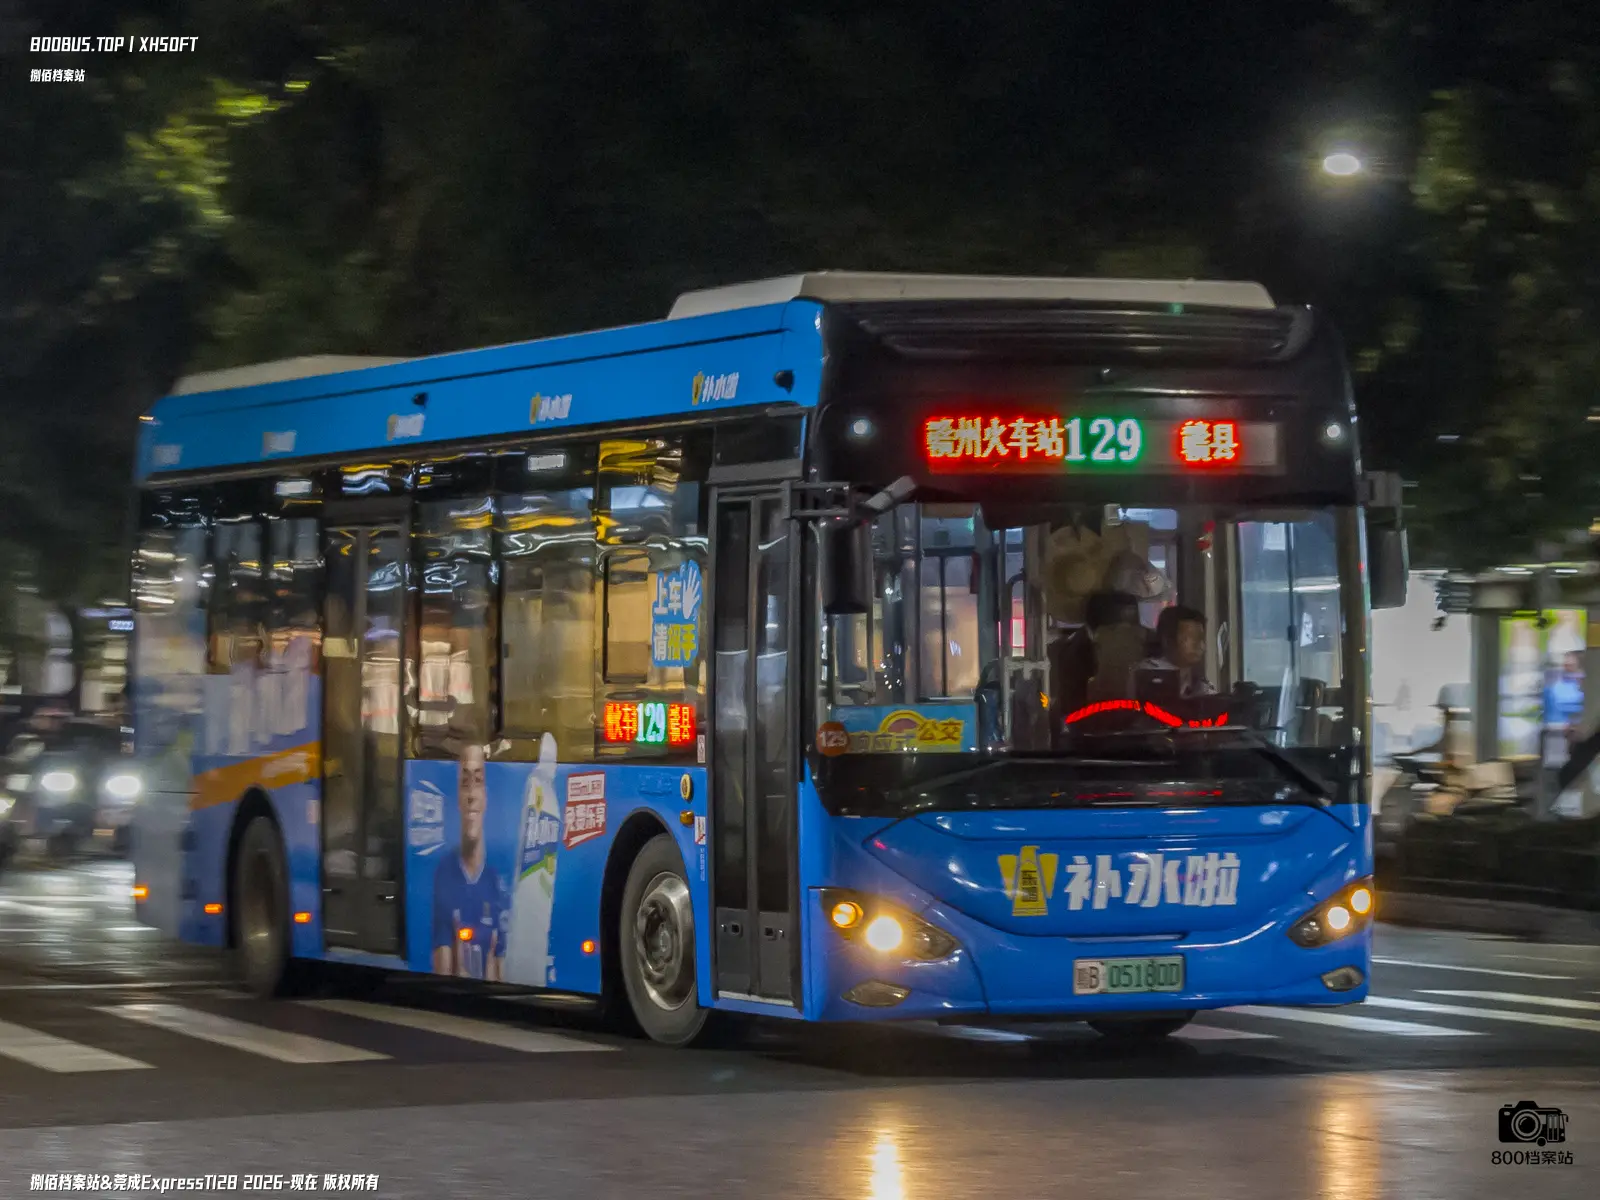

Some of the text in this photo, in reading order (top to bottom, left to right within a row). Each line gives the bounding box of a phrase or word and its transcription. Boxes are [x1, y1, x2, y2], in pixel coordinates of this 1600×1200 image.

[1063, 417, 1141, 460] 129
[654, 577, 682, 616] 上车
[636, 702, 666, 742] 129
[1064, 852, 1241, 911] 补水啦
